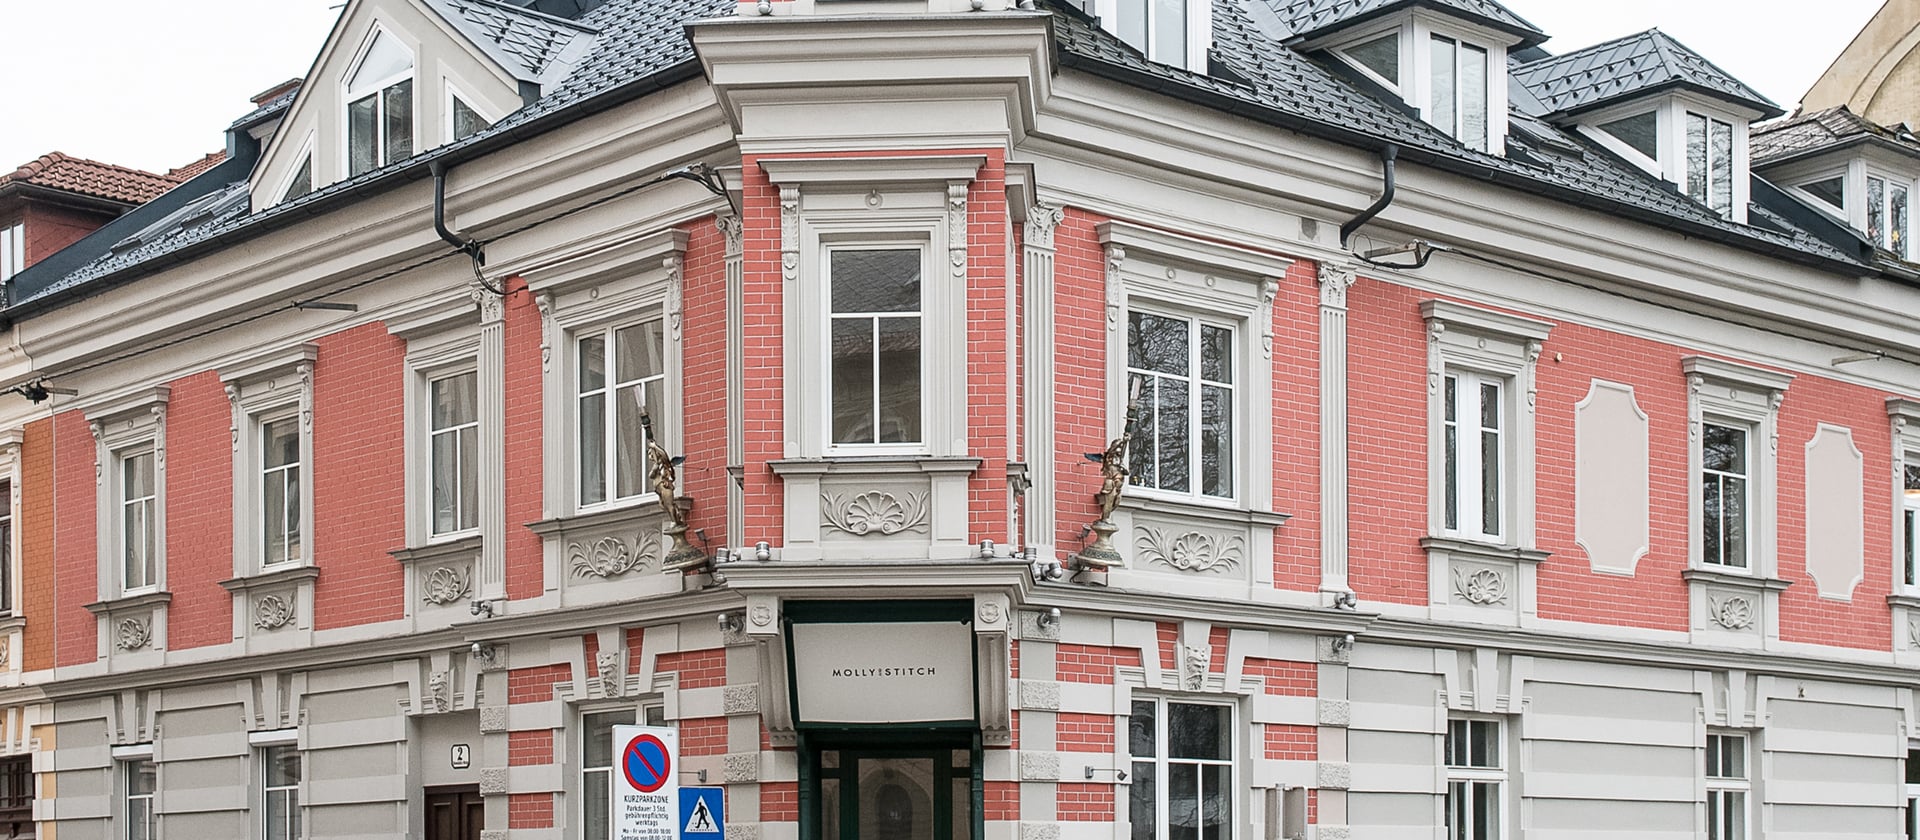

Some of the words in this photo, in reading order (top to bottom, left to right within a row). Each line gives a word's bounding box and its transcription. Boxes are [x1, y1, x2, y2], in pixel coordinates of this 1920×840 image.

[832, 669, 875, 677] MOLLY
[884, 667, 935, 676] STITCH
[457, 746, 463, 760] 2
[624, 795, 668, 803] KURZPARKZONE
[625, 812, 669, 820] gebührenpflichtig
